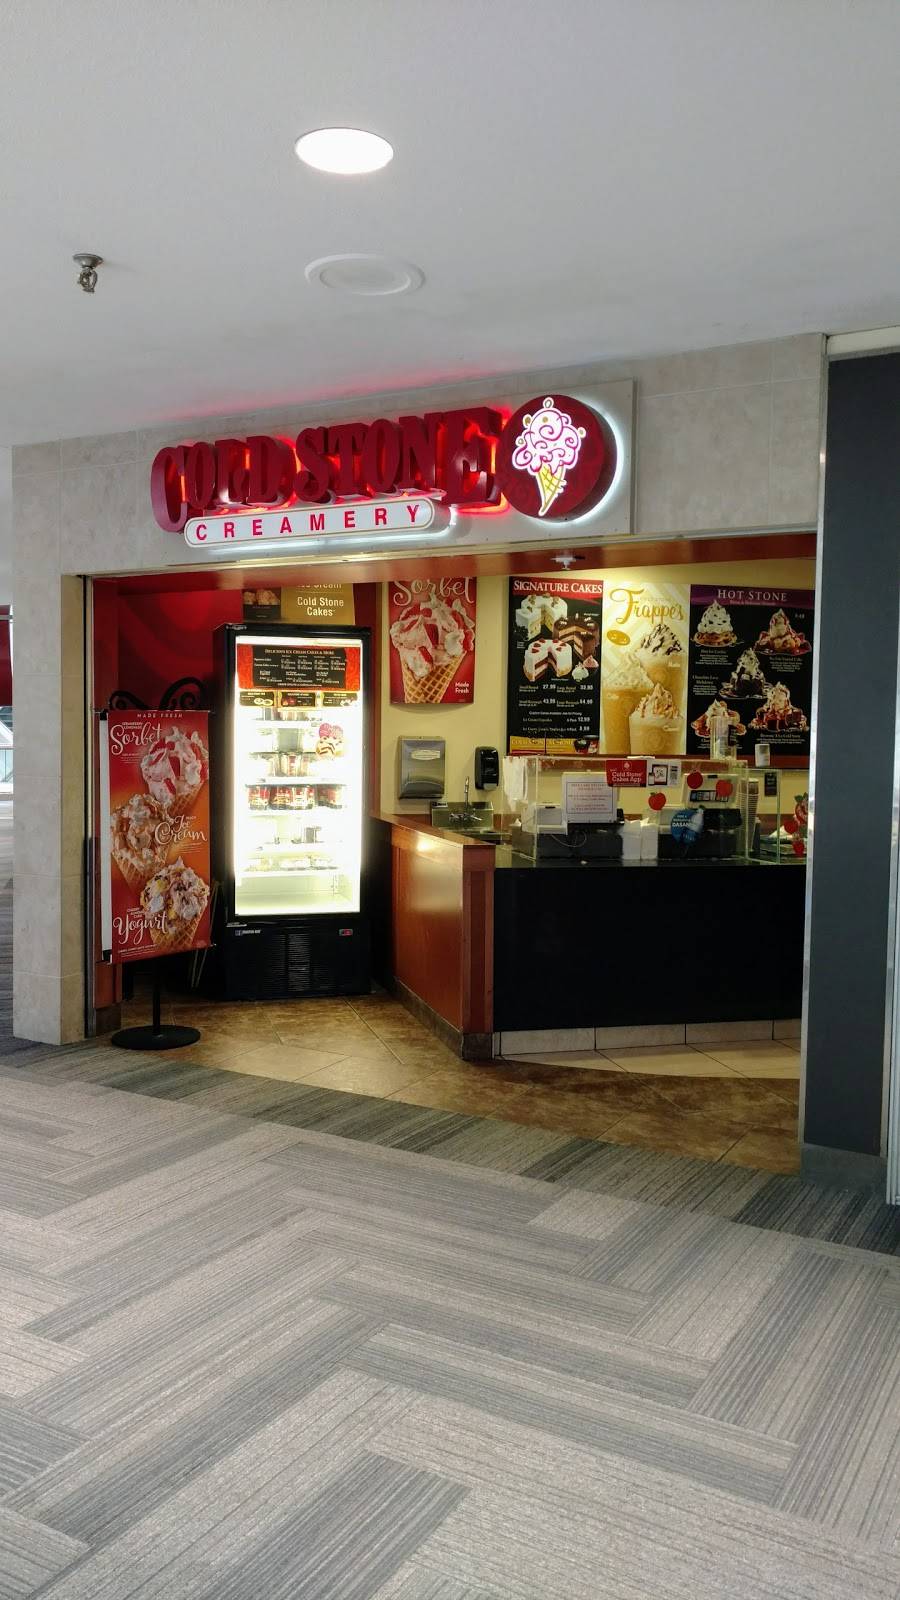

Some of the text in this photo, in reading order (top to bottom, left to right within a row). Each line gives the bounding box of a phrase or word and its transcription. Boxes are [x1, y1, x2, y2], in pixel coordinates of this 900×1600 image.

[151, 406, 500, 533] COLD STONE
[196, 504, 419, 541] CREAMERY
[513, 581, 603, 594] SIGNATURE CAKES
[717, 589, 788, 602] HOT STONE
[297, 596, 344, 607] Cold Stone
[306, 606, 334, 617] Cakes
[110, 721, 163, 756] Sorbet
[154, 821, 208, 845] Cream
[112, 911, 168, 946] Yogurt
